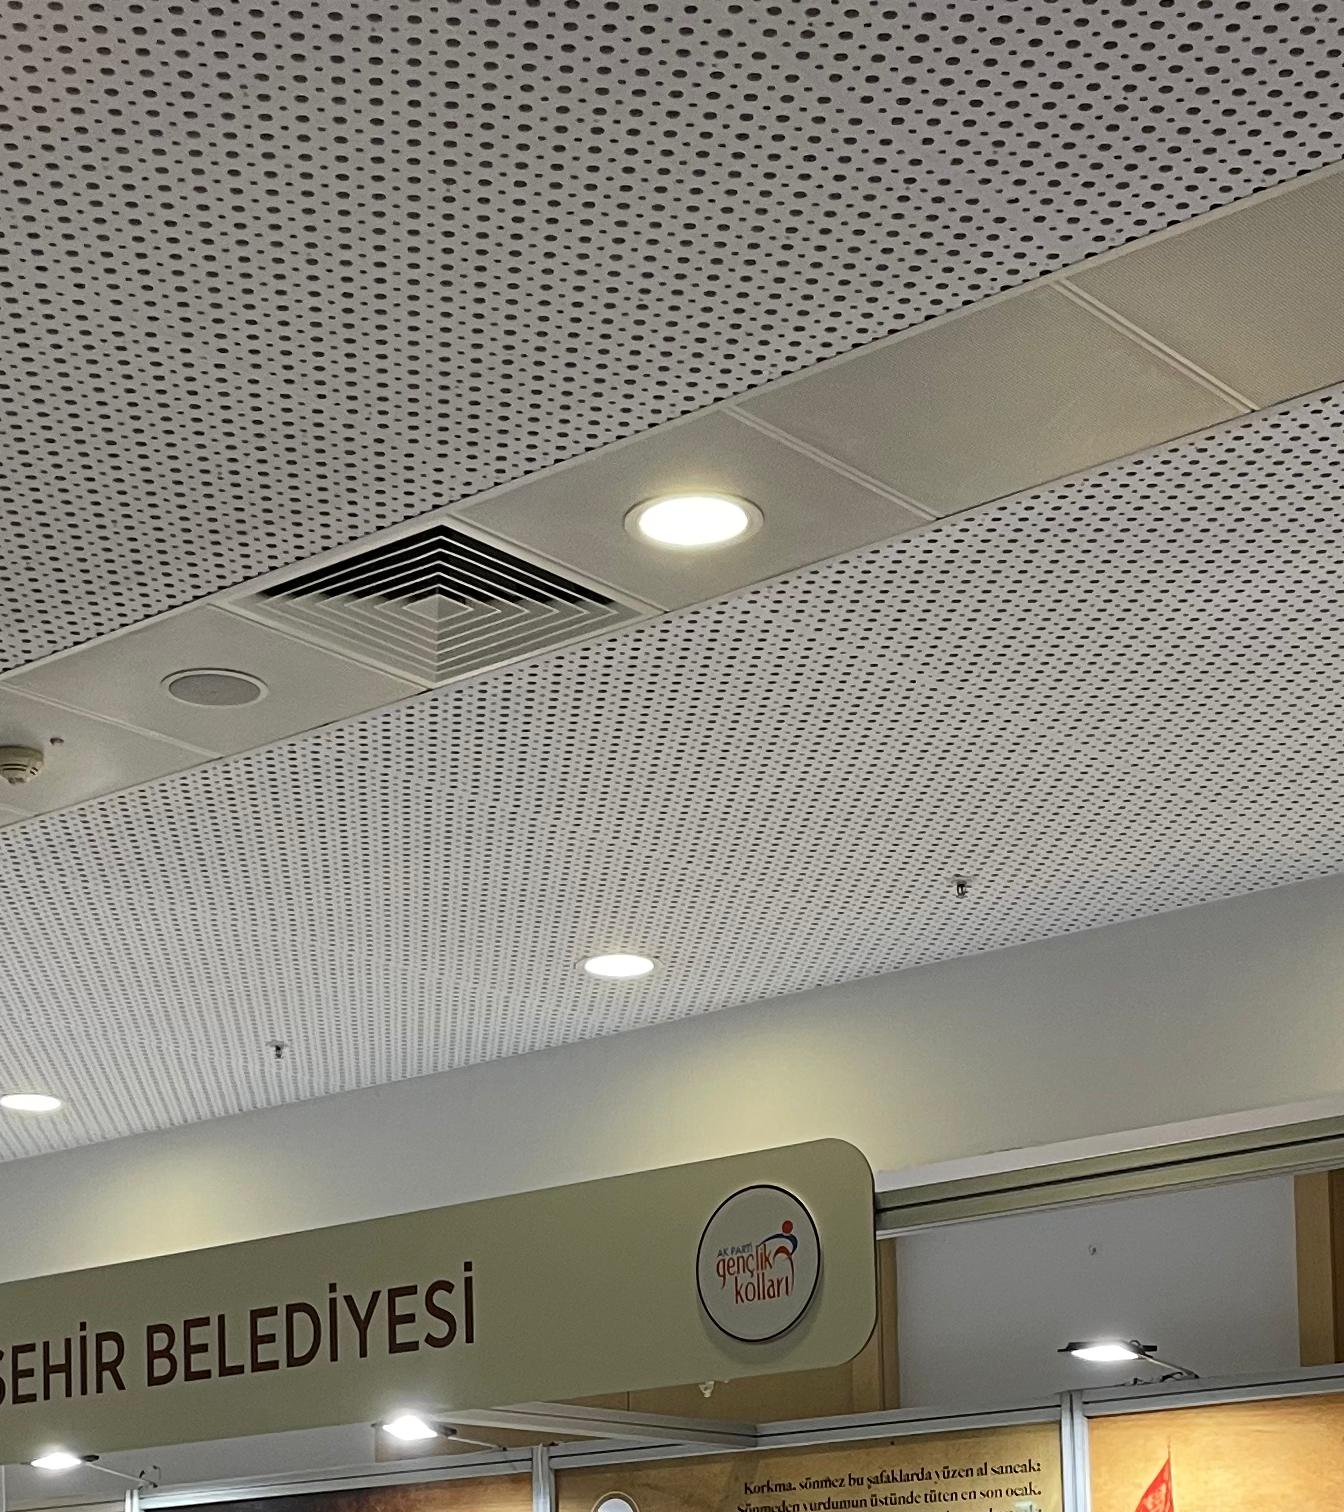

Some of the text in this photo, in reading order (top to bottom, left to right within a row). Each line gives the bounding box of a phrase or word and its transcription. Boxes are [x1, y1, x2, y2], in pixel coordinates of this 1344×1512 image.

[716, 1244, 773, 1289] gençlik
[735, 1272, 789, 1304] kolları
[147, 1260, 477, 1387] BELEDİYESİ
[799, 1477, 846, 1491] sönmez
[848, 1473, 864, 1487] bu
[867, 1467, 932, 1490] şafaklarda
[935, 1465, 974, 1484] yüzen
[976, 1462, 988, 1476] al
[870, 1490, 922, 1508] üstünde
[924, 1489, 958, 1503] tüten
[961, 1490, 977, 1501] en
[979, 1488, 1003, 1499] son
